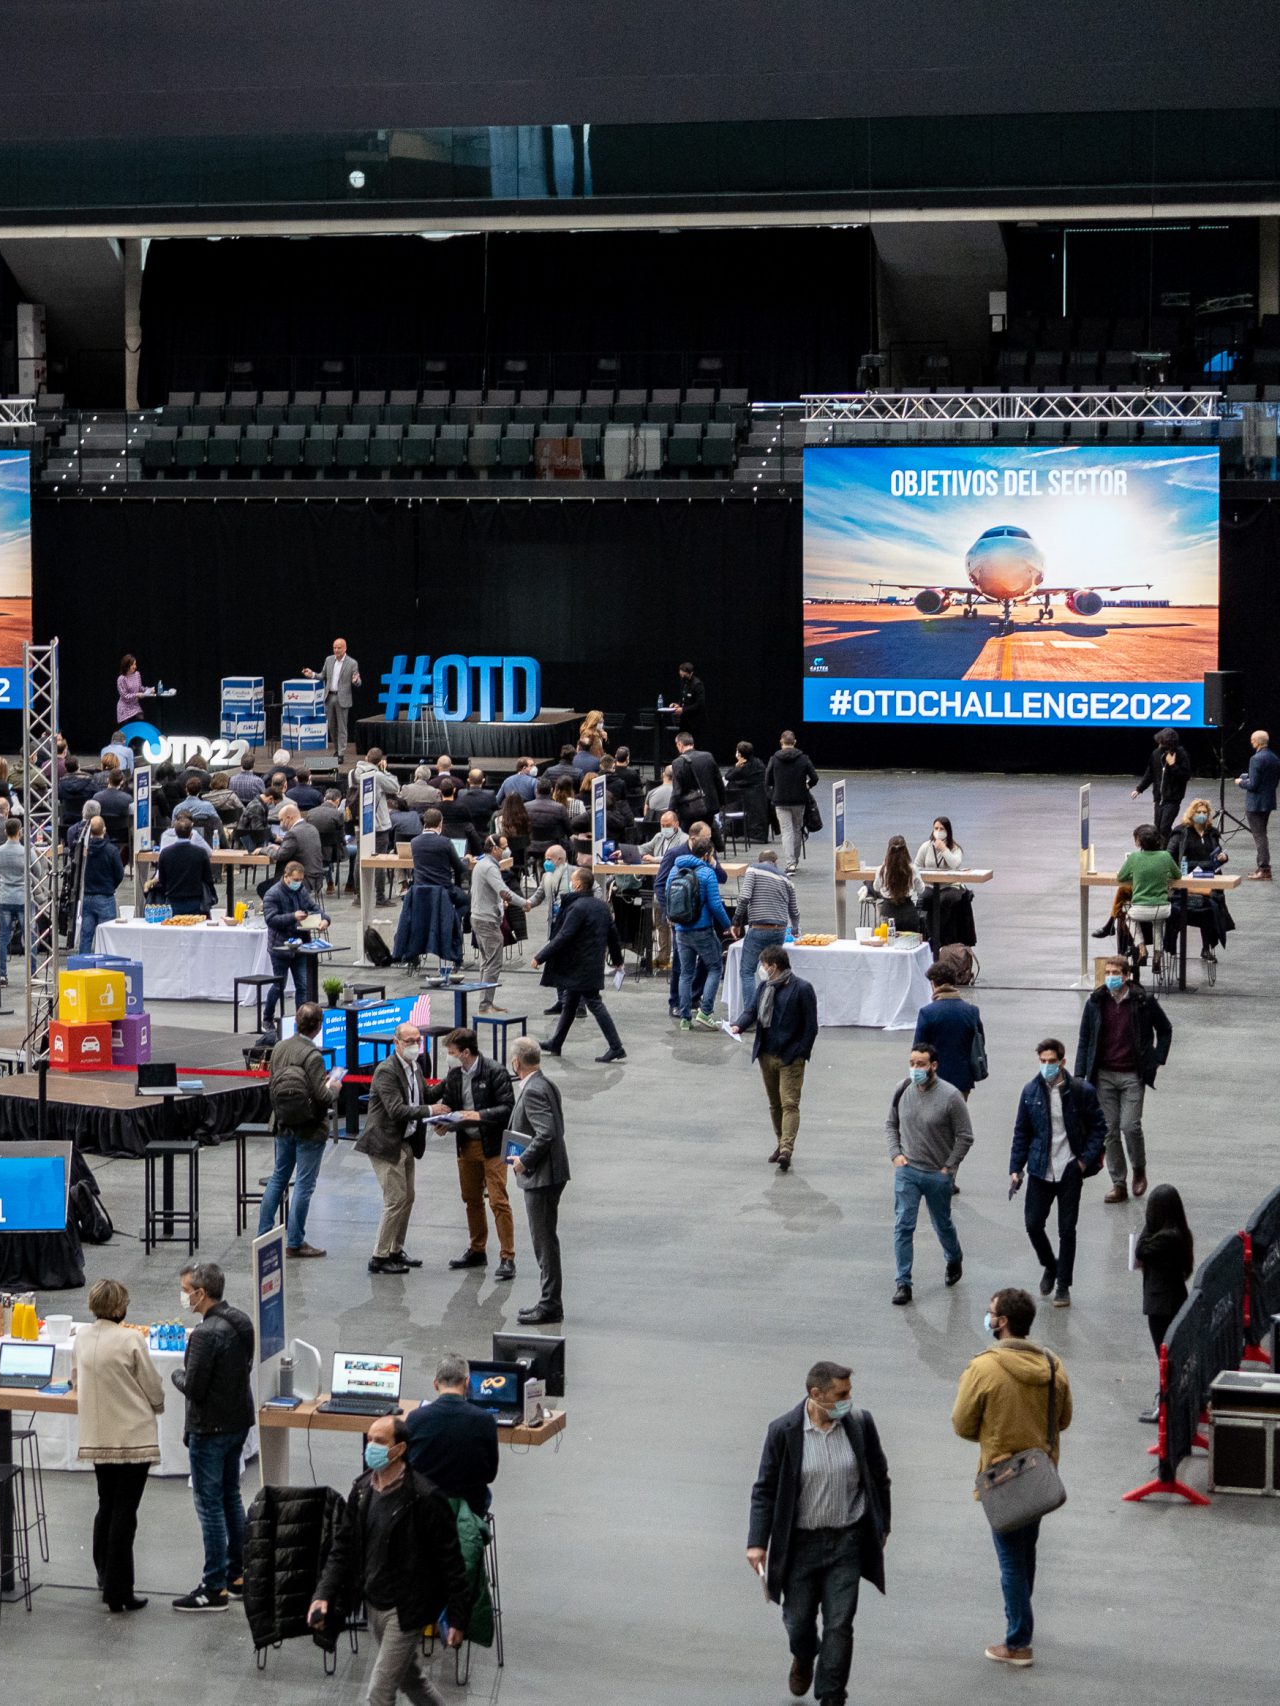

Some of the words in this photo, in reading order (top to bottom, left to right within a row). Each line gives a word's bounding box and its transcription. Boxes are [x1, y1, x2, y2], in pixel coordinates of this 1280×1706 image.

[890, 469, 999, 497] OBJETIVOS
[1004, 470, 1043, 496] DEL
[1048, 469, 1127, 497] SECTOR
[378, 654, 541, 721] #OTD
[829, 689, 1191, 720] #OTDCHALLENGE2022
